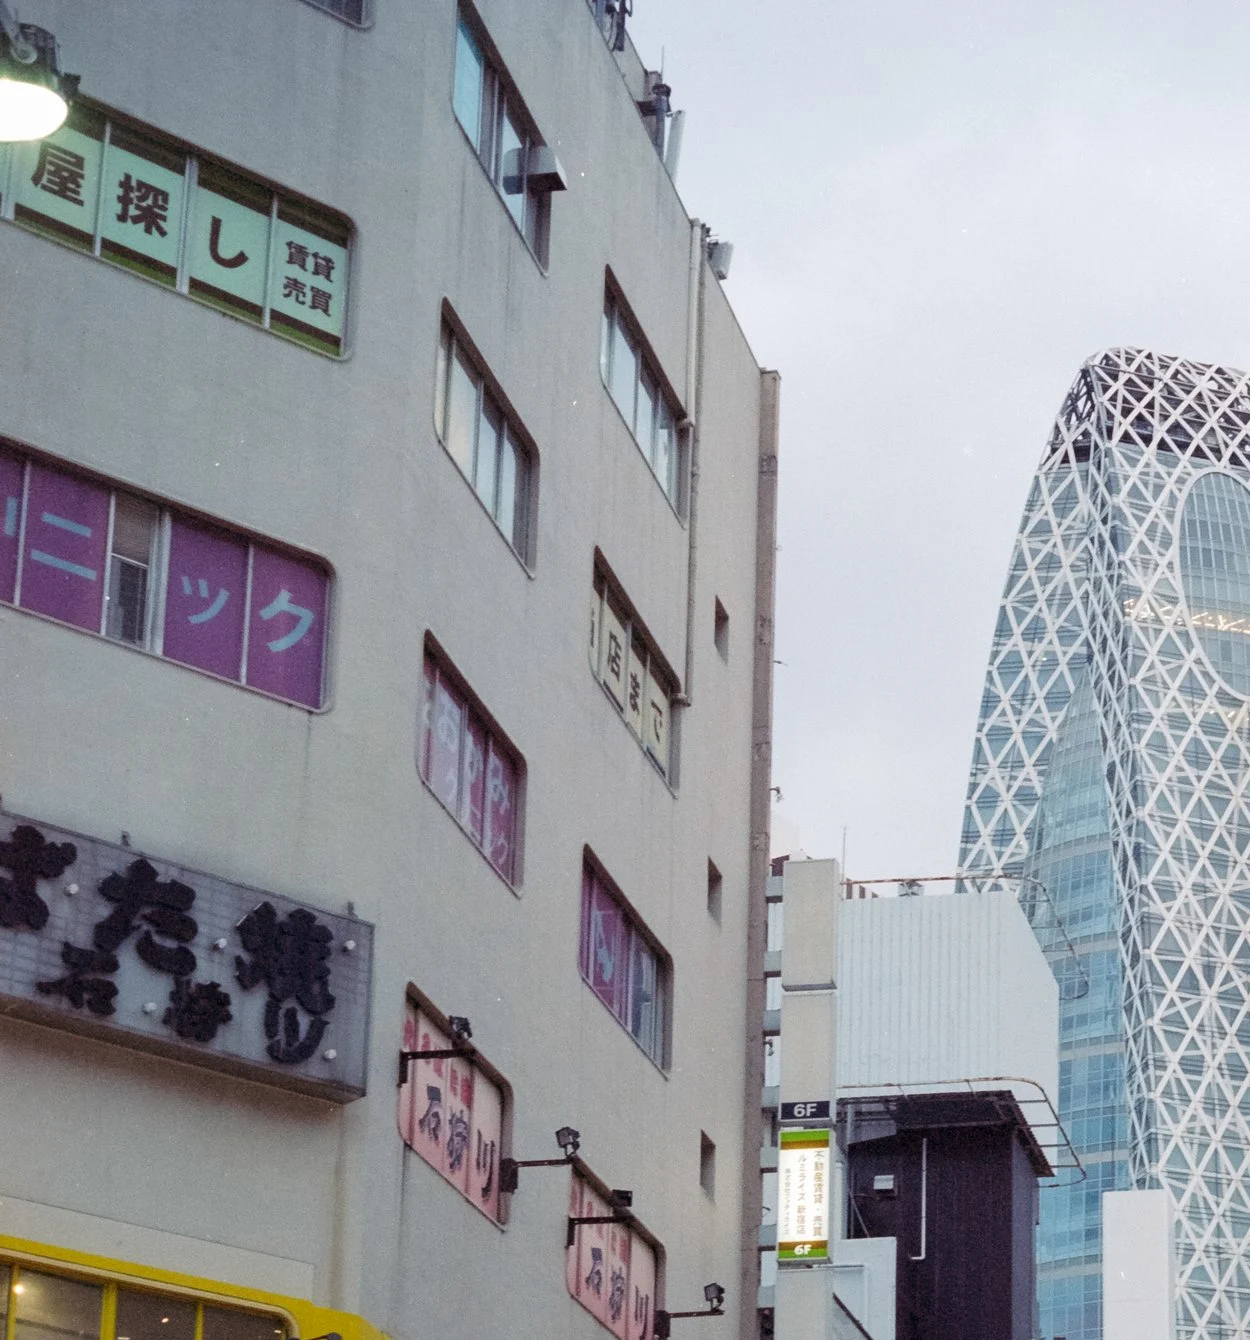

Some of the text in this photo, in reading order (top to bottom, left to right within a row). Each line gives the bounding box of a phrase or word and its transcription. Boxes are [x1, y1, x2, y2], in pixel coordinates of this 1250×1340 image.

[31, 142, 249, 269] 屋探し
[286, 240, 335, 283] 賃貸
[282, 275, 331, 317] 売買
[793, 1103, 817, 1118] 6F
[794, 1244, 812, 1256] 6F
